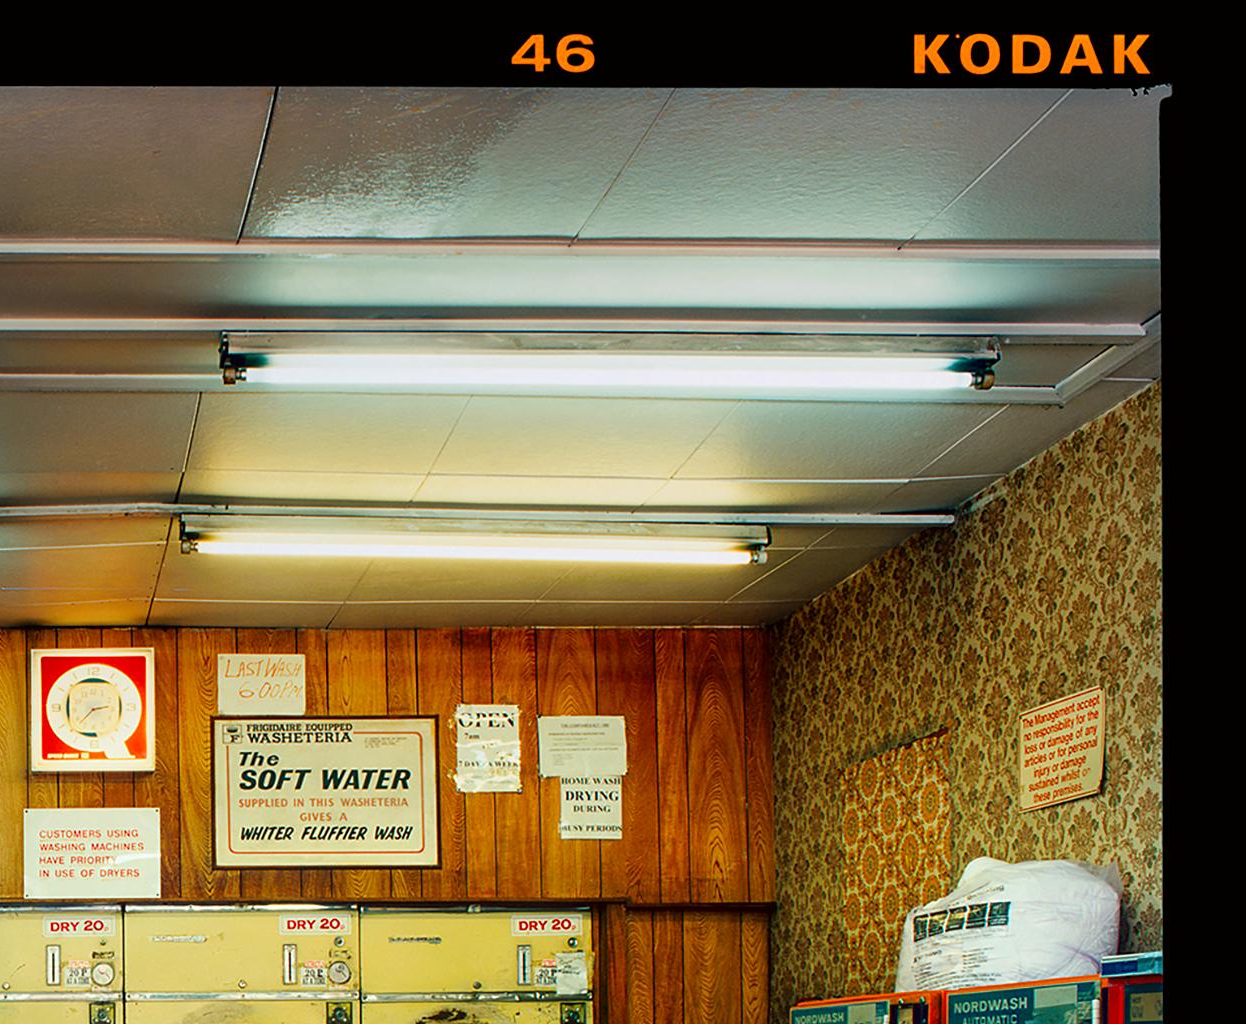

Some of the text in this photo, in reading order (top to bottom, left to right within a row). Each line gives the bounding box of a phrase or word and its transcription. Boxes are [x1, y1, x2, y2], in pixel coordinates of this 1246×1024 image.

[225, 657, 303, 678] LAST WASH
[1023, 695, 1100, 729] The Management accept
[458, 712, 515, 728] OPEN
[1024, 710, 1099, 741] no responsibility for the
[247, 723, 353, 732] FRIGIDAIRE EQUIPPED
[248, 732, 353, 743] WASHETERIA
[1025, 725, 1098, 755] loss or damage of any
[1024, 737, 1098, 768] articles or for personal
[239, 751, 279, 766] The
[1052, 763, 1059, 773] or
[1060, 755, 1087, 770] damage
[239, 769, 411, 790] SOFT WATER
[561, 777, 621, 786] HOME WASH
[1028, 775, 1059, 792] sustained
[565, 790, 619, 801] DRYING
[238, 798, 409, 808] SUPPLIED IN THIS WASHETERIA
[573, 805, 611, 813] DURING
[299, 812, 348, 822] GIVES A
[38, 829, 139, 839] CUSTOMERS USING
[240, 826, 414, 840] WHITER FLUFFIER WASH
[38, 842, 145, 852] WASHING MACHINES
[38, 855, 65, 864] HAVE
[38, 868, 140, 877] IN USE OF DRYERS
[50, 922, 80, 932] DRY
[287, 920, 316, 929] DRY
[518, 920, 548, 931] DRY
[954, 996, 1028, 1014] NORDWASH
[794, 1012, 844, 1024] NORDWASH
